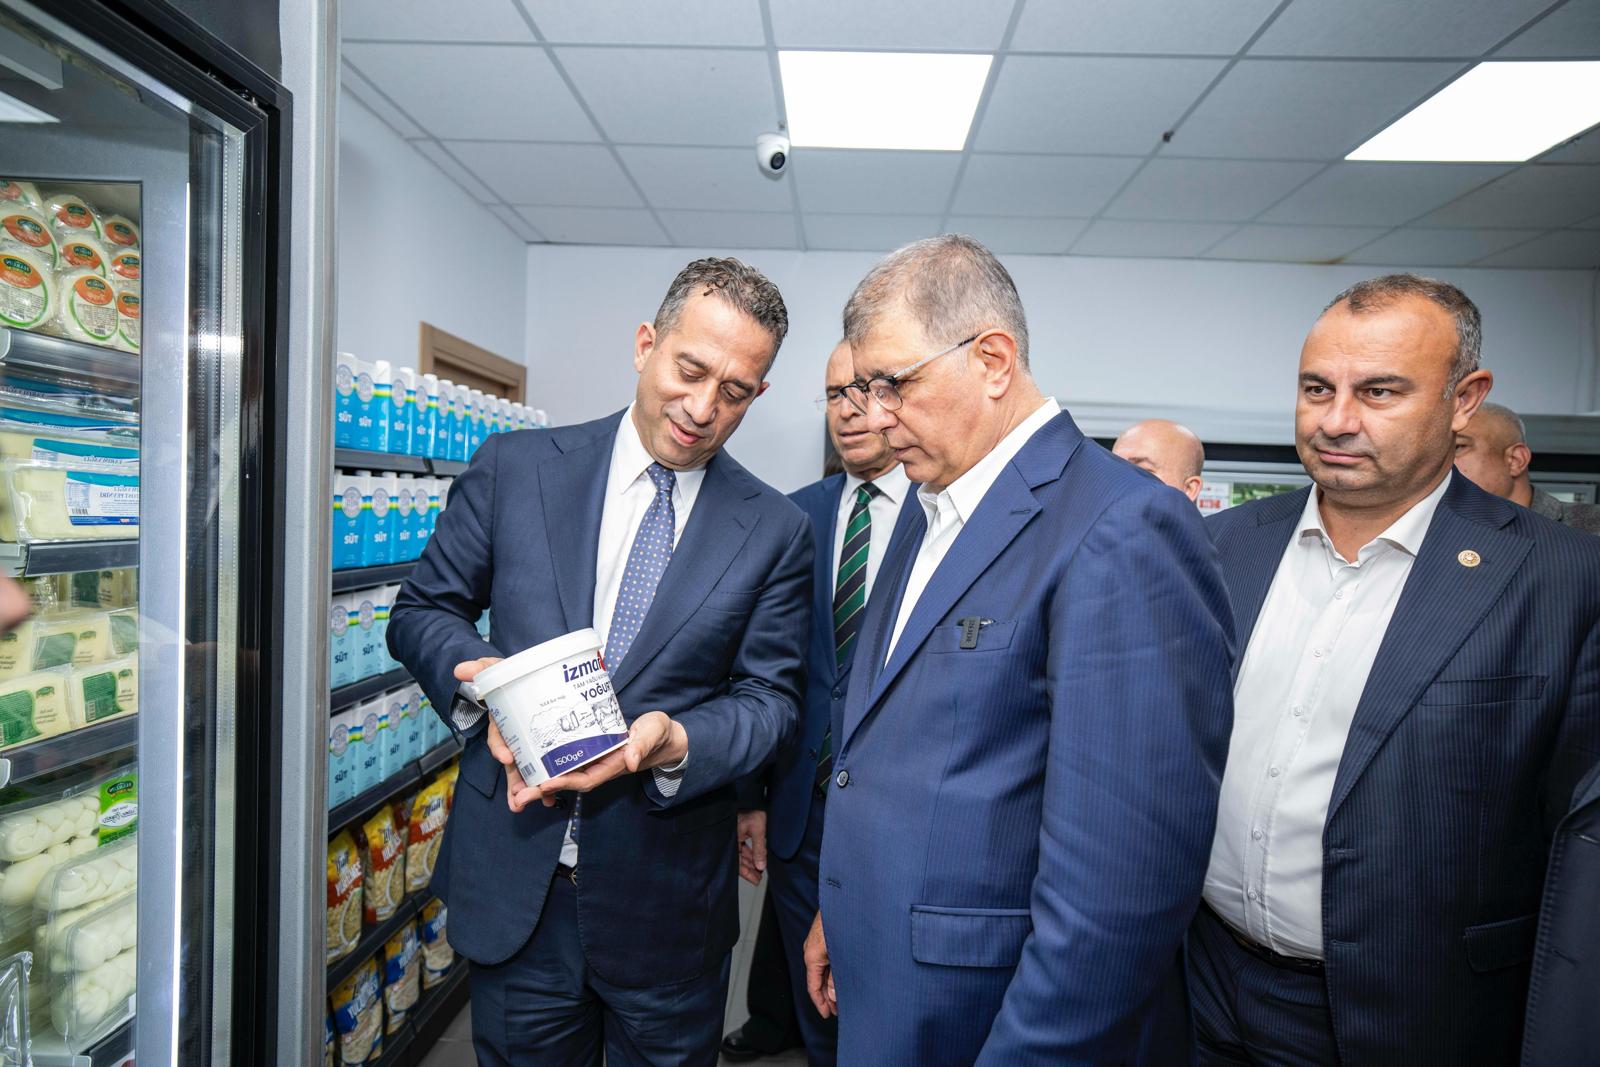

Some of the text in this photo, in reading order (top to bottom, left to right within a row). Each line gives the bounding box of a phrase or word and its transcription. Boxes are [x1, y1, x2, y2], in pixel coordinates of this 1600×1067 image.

[338, 410, 353, 424] SÜT
[358, 415, 373, 428] SÜT
[344, 532, 359, 545] SÜT
[373, 530, 388, 543] SÜT
[399, 529, 411, 541] SÜT
[417, 527, 428, 539] SÜT
[362, 643, 375, 656] SÜT
[334, 650, 349, 664] SÜT
[408, 731, 419, 743] SÜT
[389, 744, 401, 756] SÜT
[364, 756, 377, 769] SÜT
[334, 768, 349, 784] SÜT
